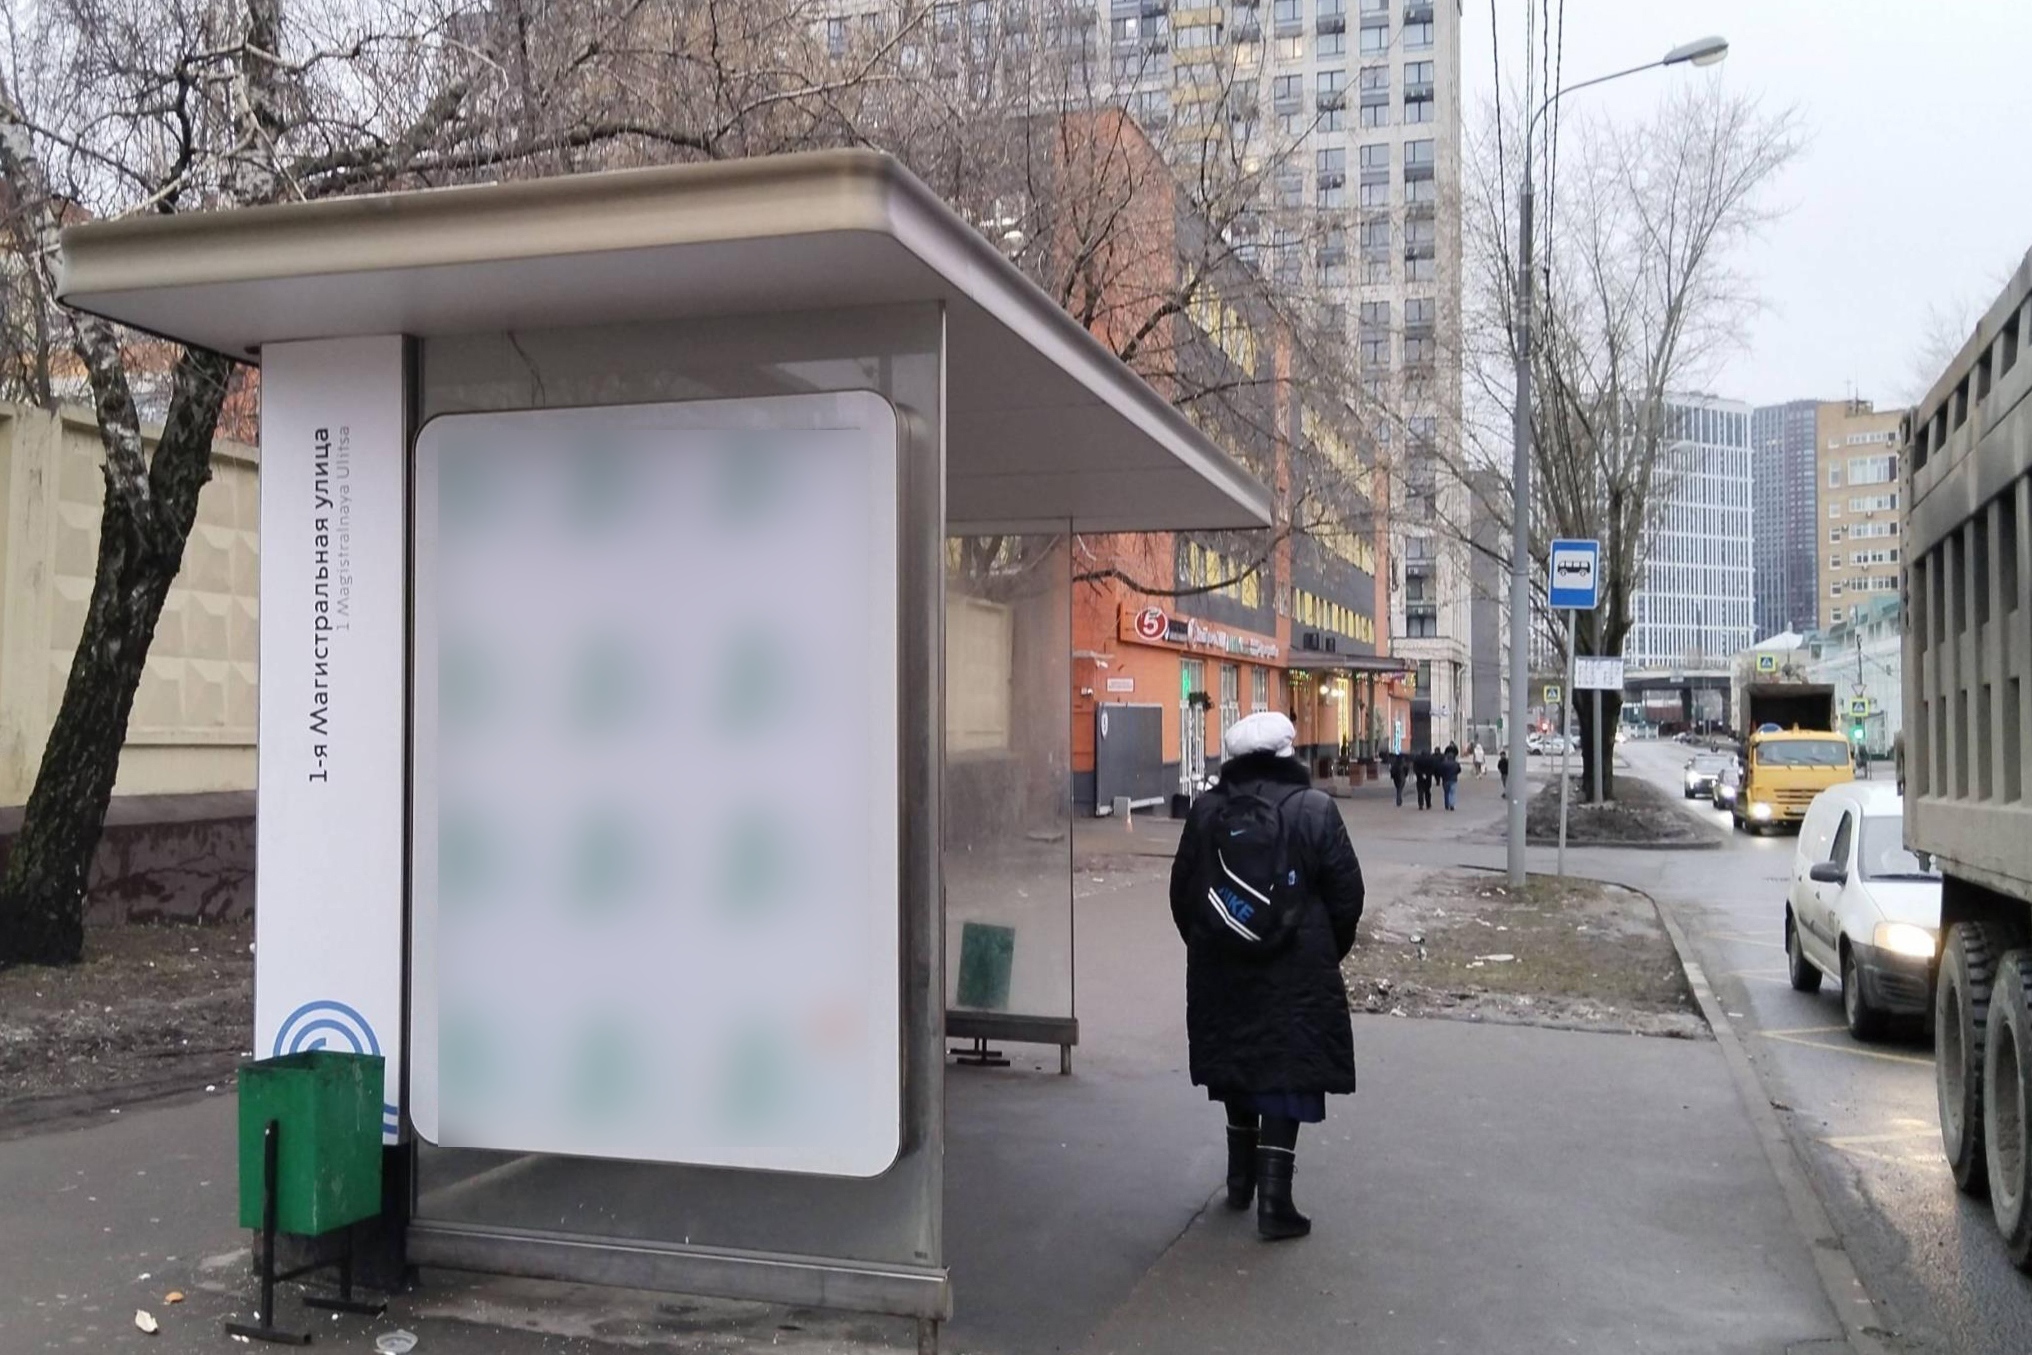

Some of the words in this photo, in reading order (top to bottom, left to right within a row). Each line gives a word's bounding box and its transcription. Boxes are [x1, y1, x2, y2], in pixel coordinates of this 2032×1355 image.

[315, 427, 333, 509] улица
[336, 426, 351, 479] Ulitsa
[336, 484, 353, 617] Magistralnaya
[309, 517, 333, 735] Магистральная
[1142, 608, 1160, 635] 5
[310, 744, 328, 781] 1-я
